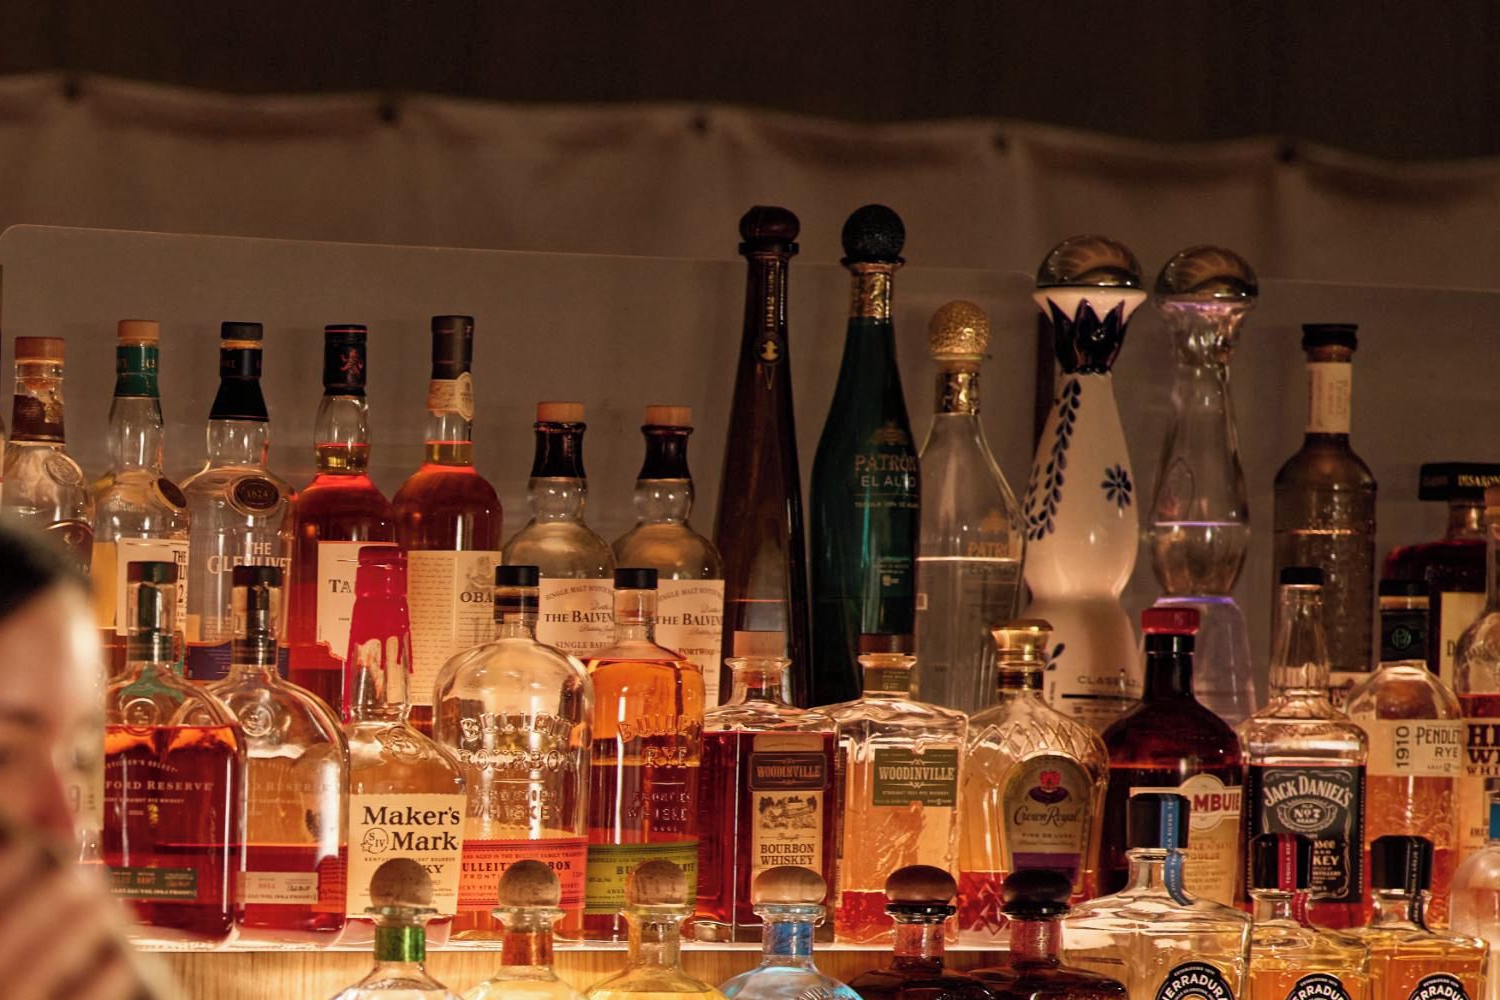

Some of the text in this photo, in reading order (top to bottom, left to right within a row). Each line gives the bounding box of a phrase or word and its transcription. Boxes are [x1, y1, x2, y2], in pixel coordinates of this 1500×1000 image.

[861, 475, 917, 488] EL ALTO
[247, 542, 272, 556] THE
[545, 613, 568, 623] THE
[556, 641, 587, 649] SINGLE
[1396, 726, 1410, 769] 1910
[1434, 747, 1459, 758] RYE
[756, 765, 821, 778] WOODINVILLE
[879, 766, 956, 781] WOODINVILLE
[147, 780, 214, 791] RESERVE
[1263, 775, 1354, 809] JACK DANIEL'S
[1192, 793, 1241, 812] MBUIE
[361, 806, 461, 826] Maker's
[1013, 805, 1080, 828] Crown Royal
[389, 831, 458, 851] Mark
[760, 843, 815, 854] BOURBON
[462, 862, 506, 872] ULLEIT
[760, 855, 815, 866] WHISKEY
